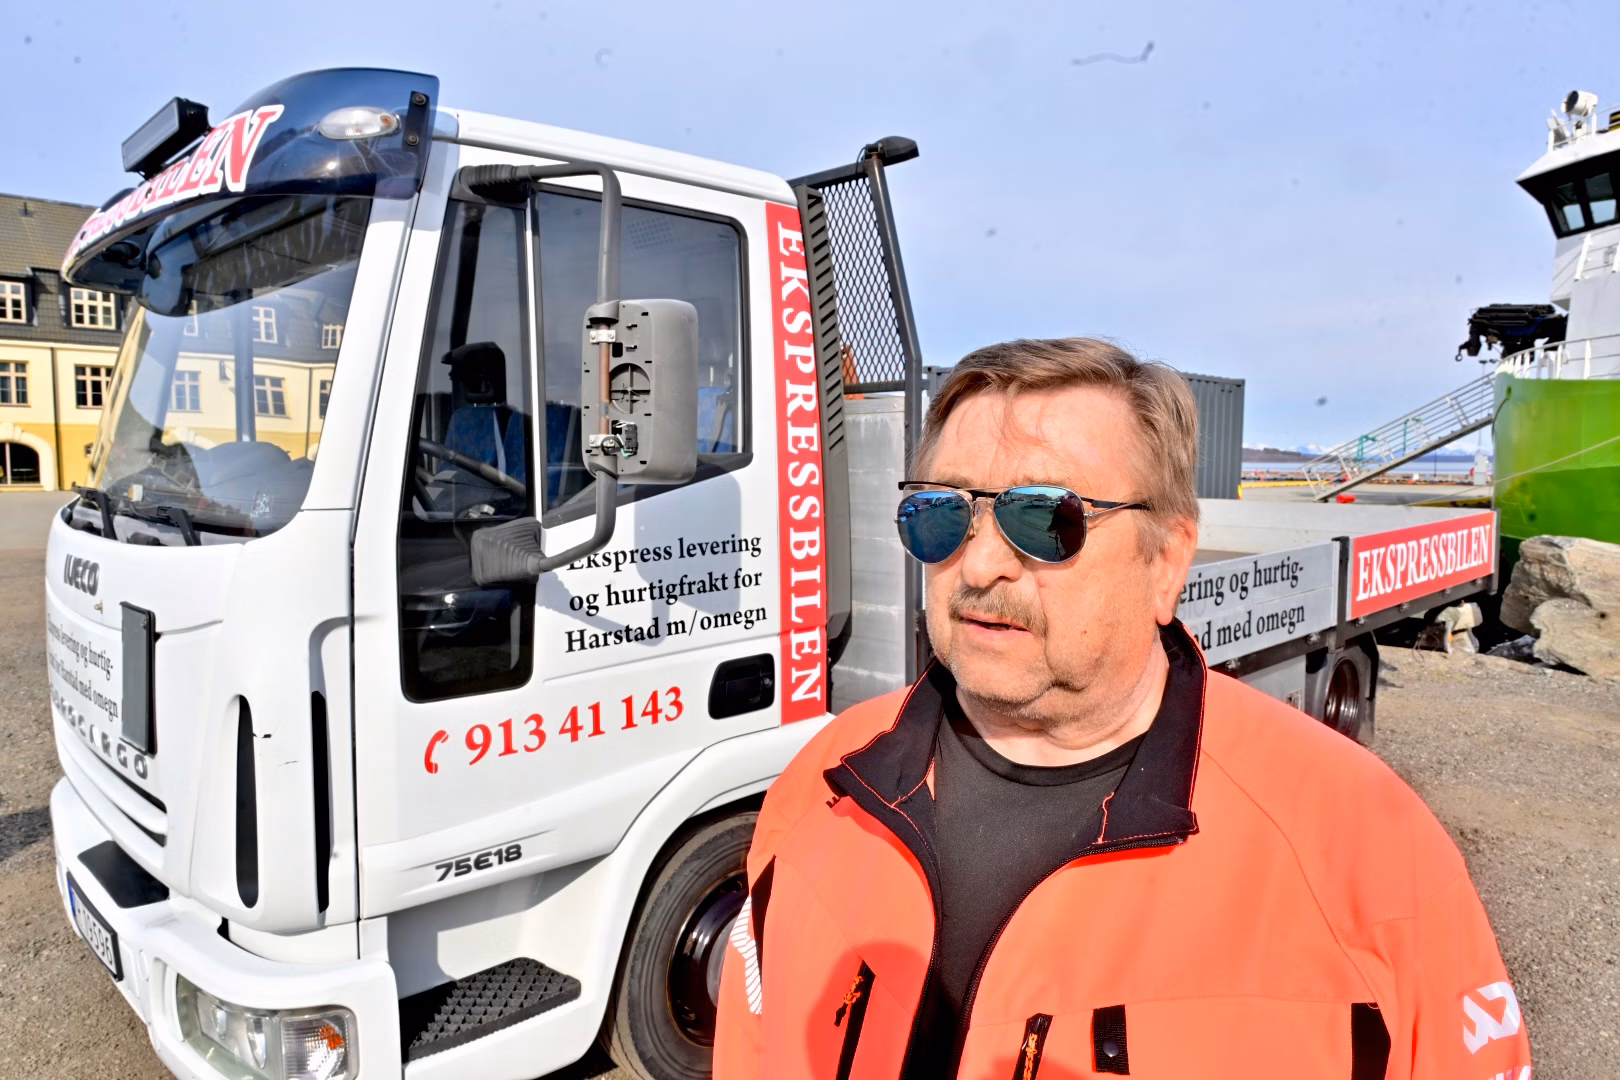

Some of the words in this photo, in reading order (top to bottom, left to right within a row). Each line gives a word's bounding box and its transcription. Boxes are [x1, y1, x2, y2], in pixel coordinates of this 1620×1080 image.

[777, 220, 821, 703] EKSPRESSBILEN
[677, 534, 762, 559] levering
[1355, 524, 1491, 602] EKSPRESSBILEN
[63, 553, 100, 596] IVECO
[569, 592, 600, 617] og
[605, 573, 729, 607] hurtigfrakt
[734, 567, 763, 589] for
[1179, 572, 1225, 606] ering
[1229, 571, 1249, 600] og
[1253, 555, 1304, 588] hurtig-
[564, 616, 661, 653] Harstad
[1216, 610, 1252, 647] med
[1256, 604, 1305, 635] omegn
[88, 640, 113, 681] hurtig-
[93, 690, 119, 722] omegn
[464, 712, 547, 766] 913
[558, 700, 606, 743] 41
[620, 685, 685, 731] 143
[434, 843, 523, 883] 75E18
